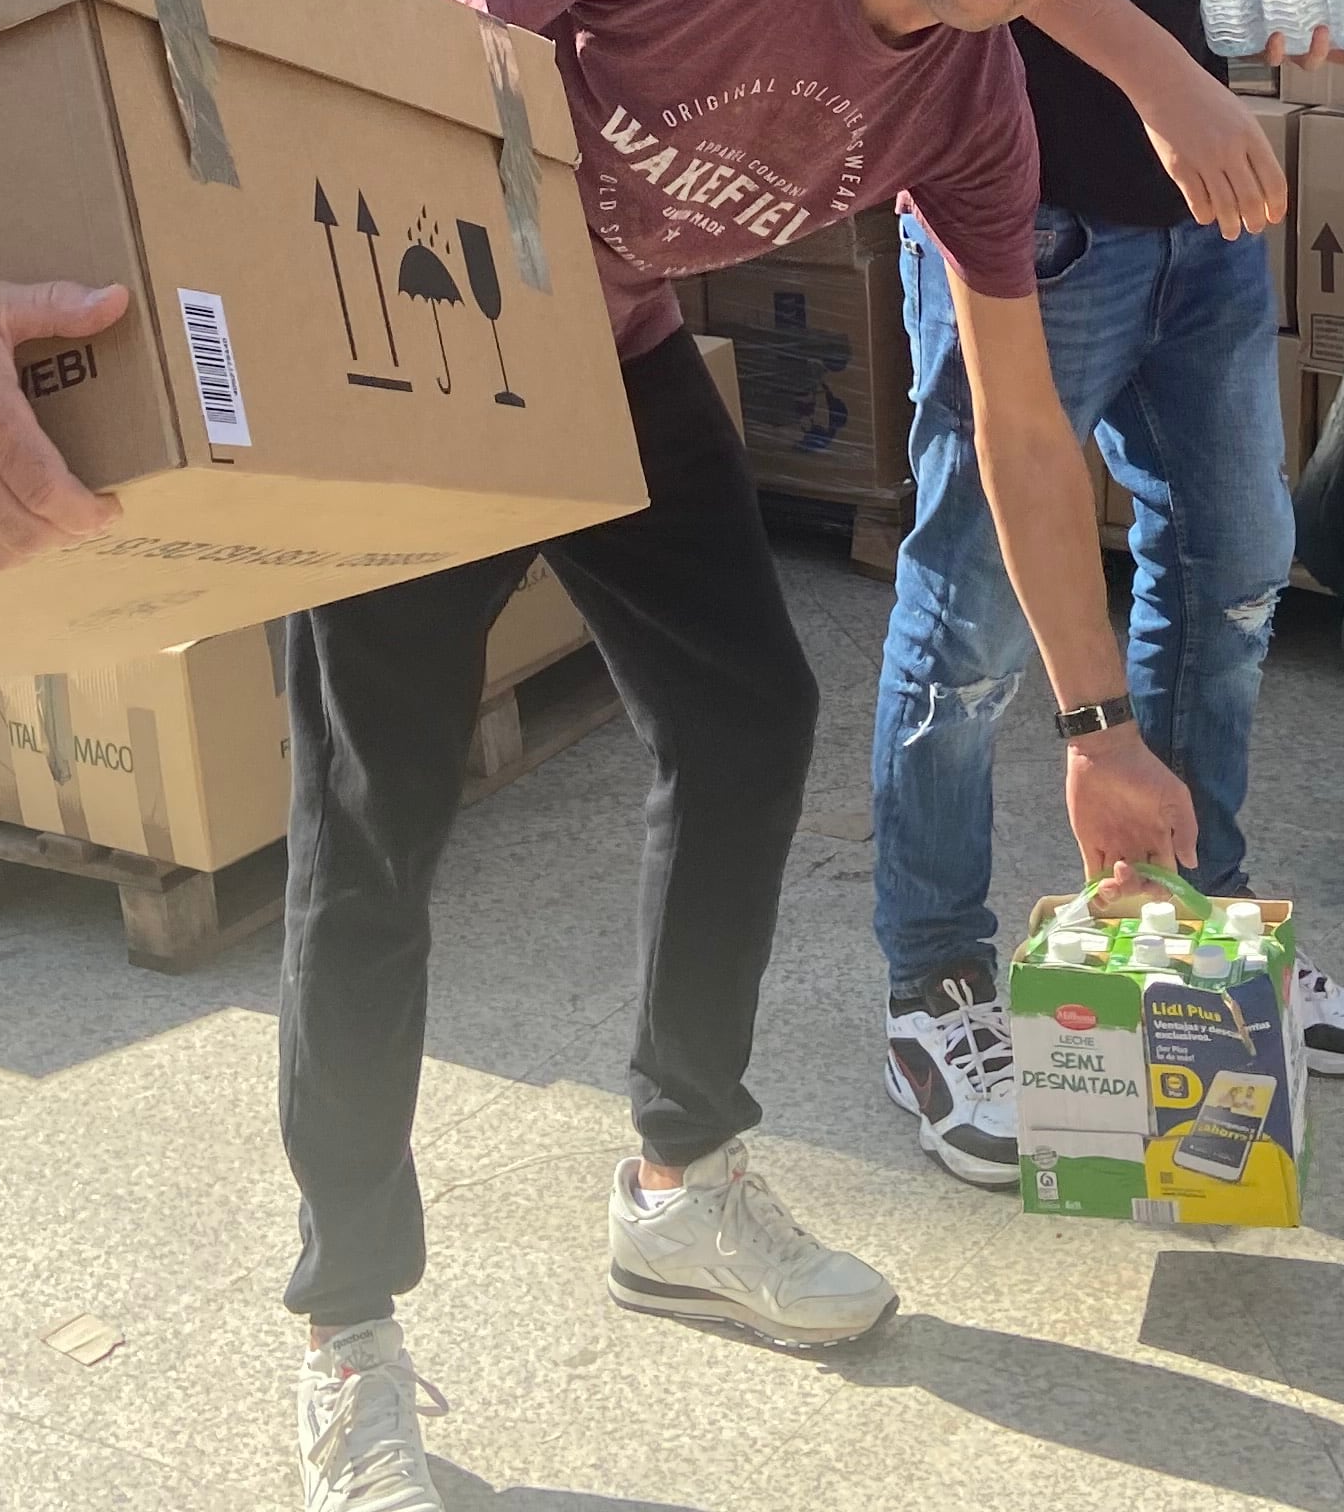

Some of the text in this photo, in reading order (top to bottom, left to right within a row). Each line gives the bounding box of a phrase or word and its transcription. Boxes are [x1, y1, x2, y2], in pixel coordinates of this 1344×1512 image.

[660, 77, 777, 129] ORIGINAL
[694, 138, 746, 165] APPAREL
[598, 173, 619, 212] OLD
[690, 212, 727, 237] MADE
[1152, 1001, 1223, 1023] Lidl Plus
[1153, 1019, 1199, 1032] Ventajas
[1058, 1034, 1095, 1048] LECHE
[1049, 1050, 1106, 1074] SEMI
[1022, 1069, 1139, 1099] DESNATADA
